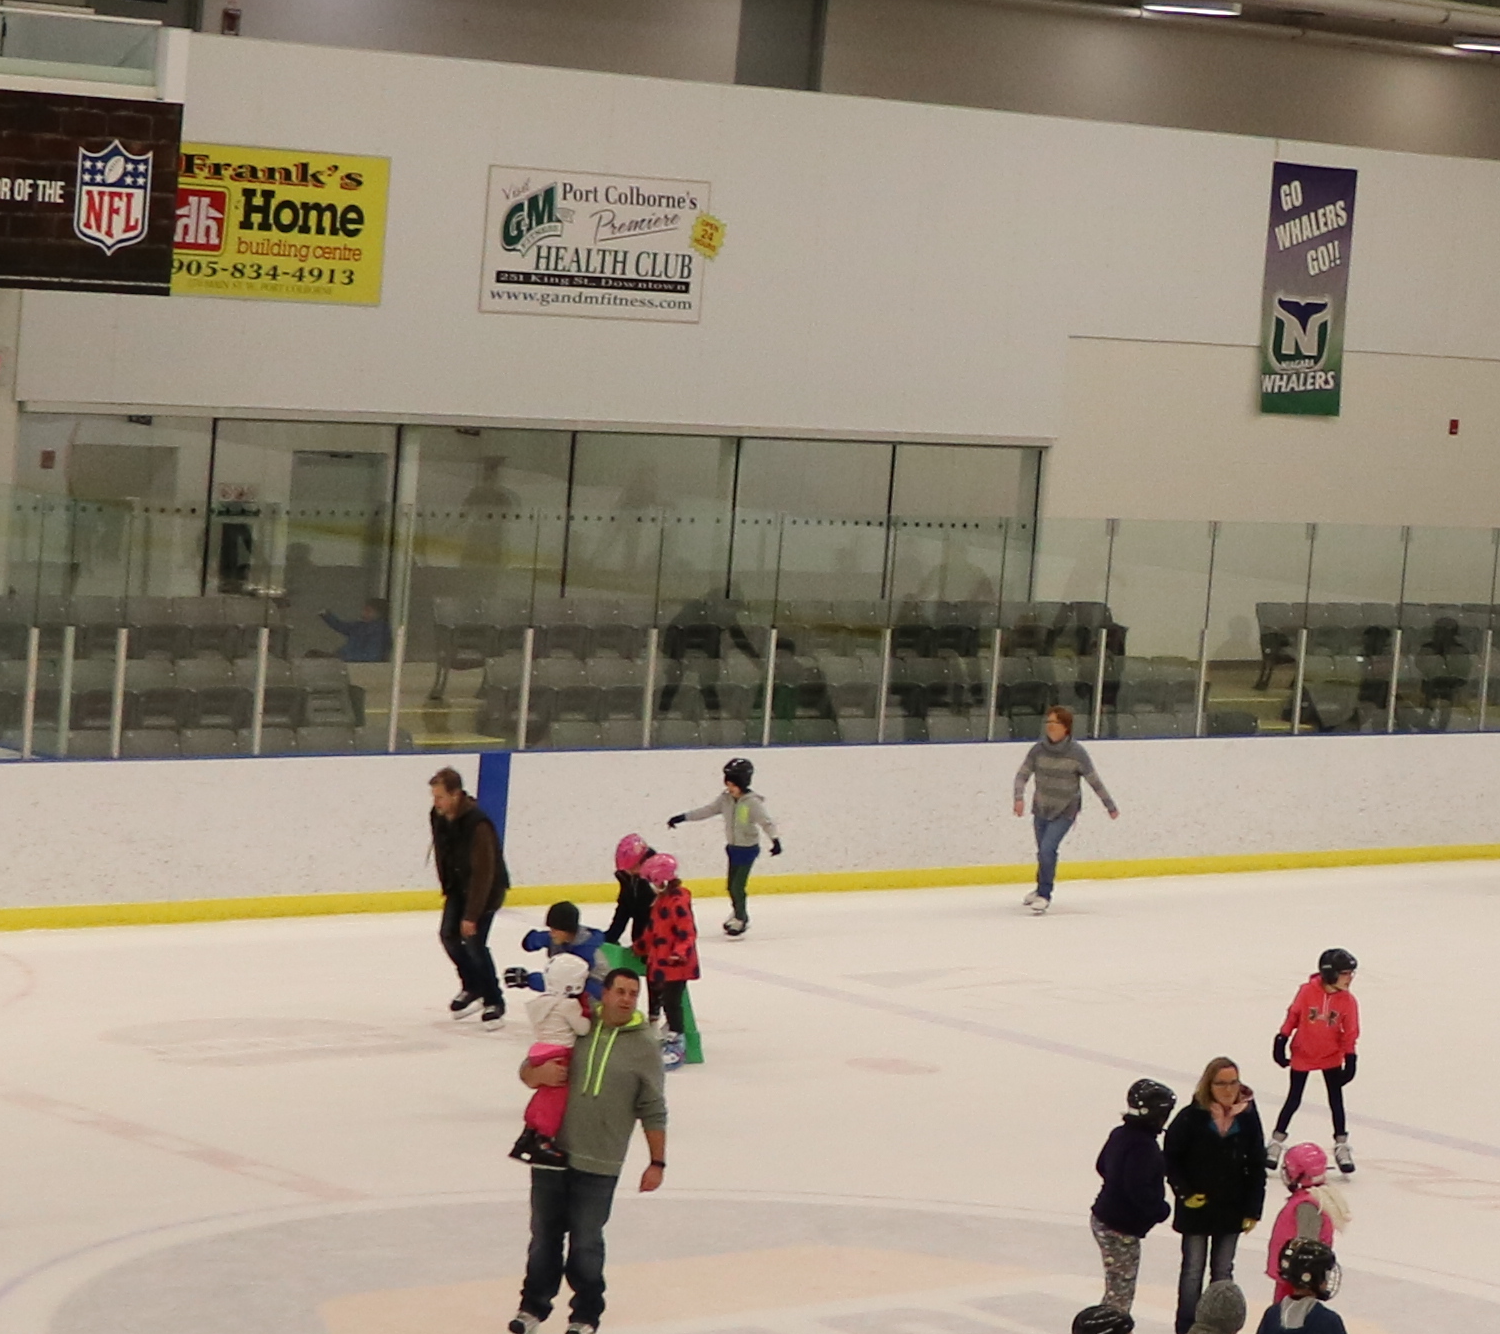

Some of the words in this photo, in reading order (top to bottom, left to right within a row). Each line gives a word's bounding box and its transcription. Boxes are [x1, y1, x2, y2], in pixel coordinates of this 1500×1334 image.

[181, 153, 364, 191] Frank's
[14, 179, 33, 201] OF
[37, 181, 64, 203] THE
[562, 183, 599, 203] Port
[605, 185, 698, 209] Colborne's
[1280, 180, 1303, 212] GO
[84, 190, 140, 236] NFL
[239, 188, 364, 237] Home
[590, 209, 681, 244] Premiere
[1274, 200, 1348, 251] WHALERS
[237, 237, 311, 262] building
[313, 243, 362, 261] centre
[701, 229, 713, 241] 24
[171, 258, 355, 286] 905-834-4913
[535, 245, 629, 275] HEALTH
[636, 252, 692, 279] CLUB
[1306, 241, 1341, 276] GO!!
[500, 273, 524, 282] 251
[529, 274, 569, 285] King
[600, 278, 686, 291] Downtown
[490, 289, 692, 310] www.gandmfitness.com
[1262, 370, 1336, 393] WHALERS
